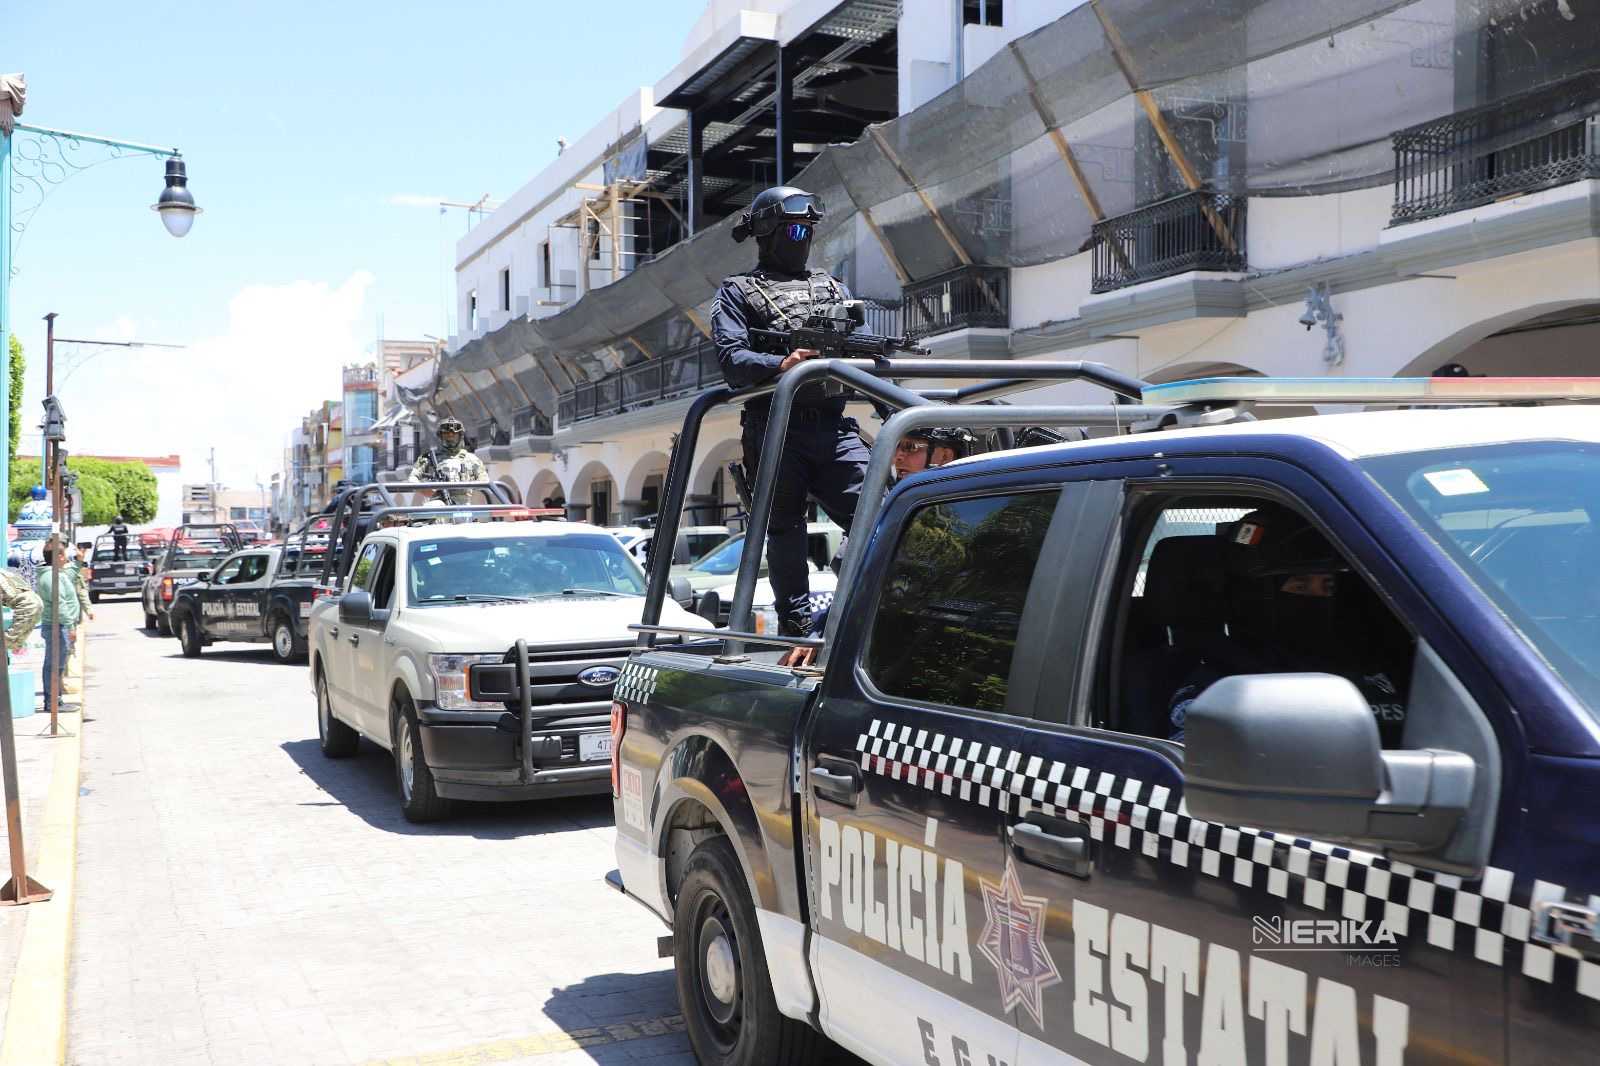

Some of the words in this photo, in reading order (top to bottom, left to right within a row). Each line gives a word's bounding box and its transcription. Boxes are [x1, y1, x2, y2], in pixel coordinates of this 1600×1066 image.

[236, 602, 261, 617] ESTATAL
[590, 671, 612, 683] Ford
[819, 816, 974, 985] POLICÍA
